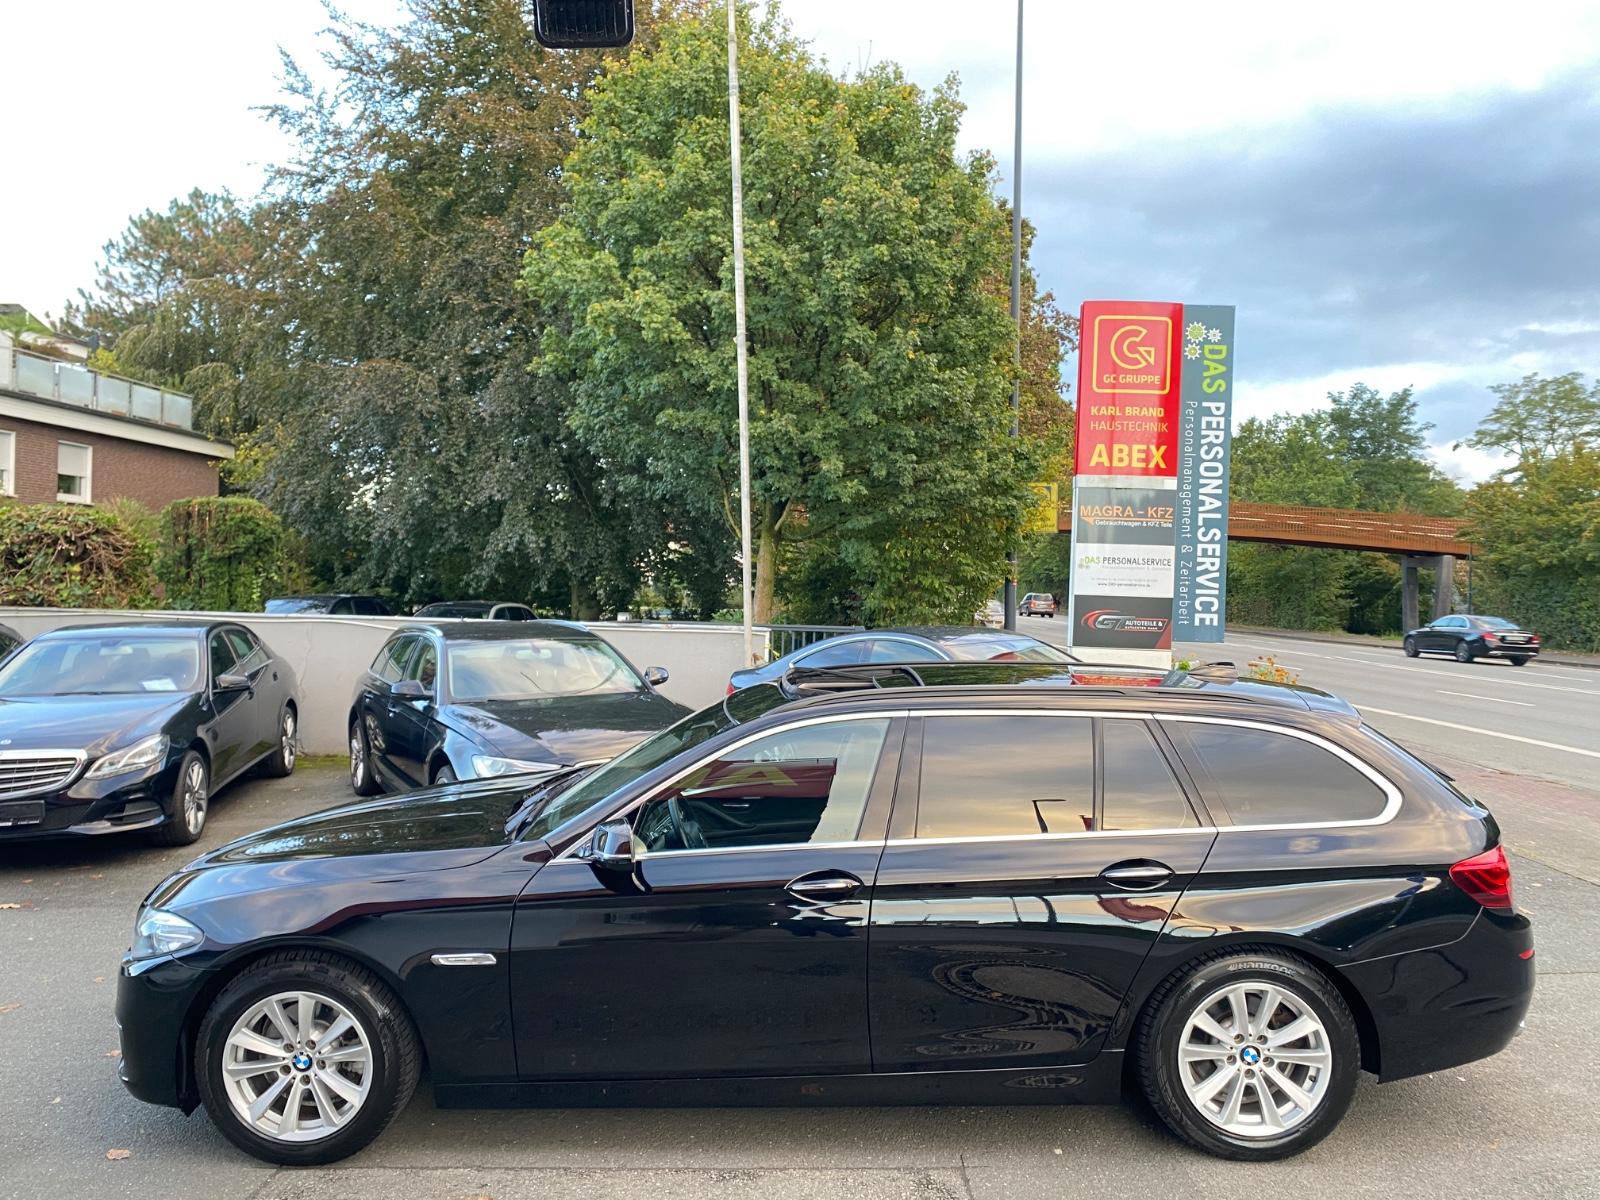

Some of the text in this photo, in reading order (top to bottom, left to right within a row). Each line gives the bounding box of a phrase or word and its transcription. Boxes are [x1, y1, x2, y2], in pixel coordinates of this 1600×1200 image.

[1103, 374, 1161, 385] GC GRUPPE
[1090, 406, 1164, 417] KARL BRAND
[1090, 420, 1168, 432] HAUSTECHNIK
[1089, 443, 1168, 468] ABEX
[1194, 344, 1229, 626] DAS PERSONALSERVICE
[1080, 505, 1134, 517] MAGRA
[1147, 507, 1174, 519] KFZ
[1178, 401, 1198, 625] Personalmanagement & Zeitarbeit
[1095, 519, 1142, 528] Gebrauchtwagen
[1084, 556, 1172, 567] DAS PERSONALSERVICE
